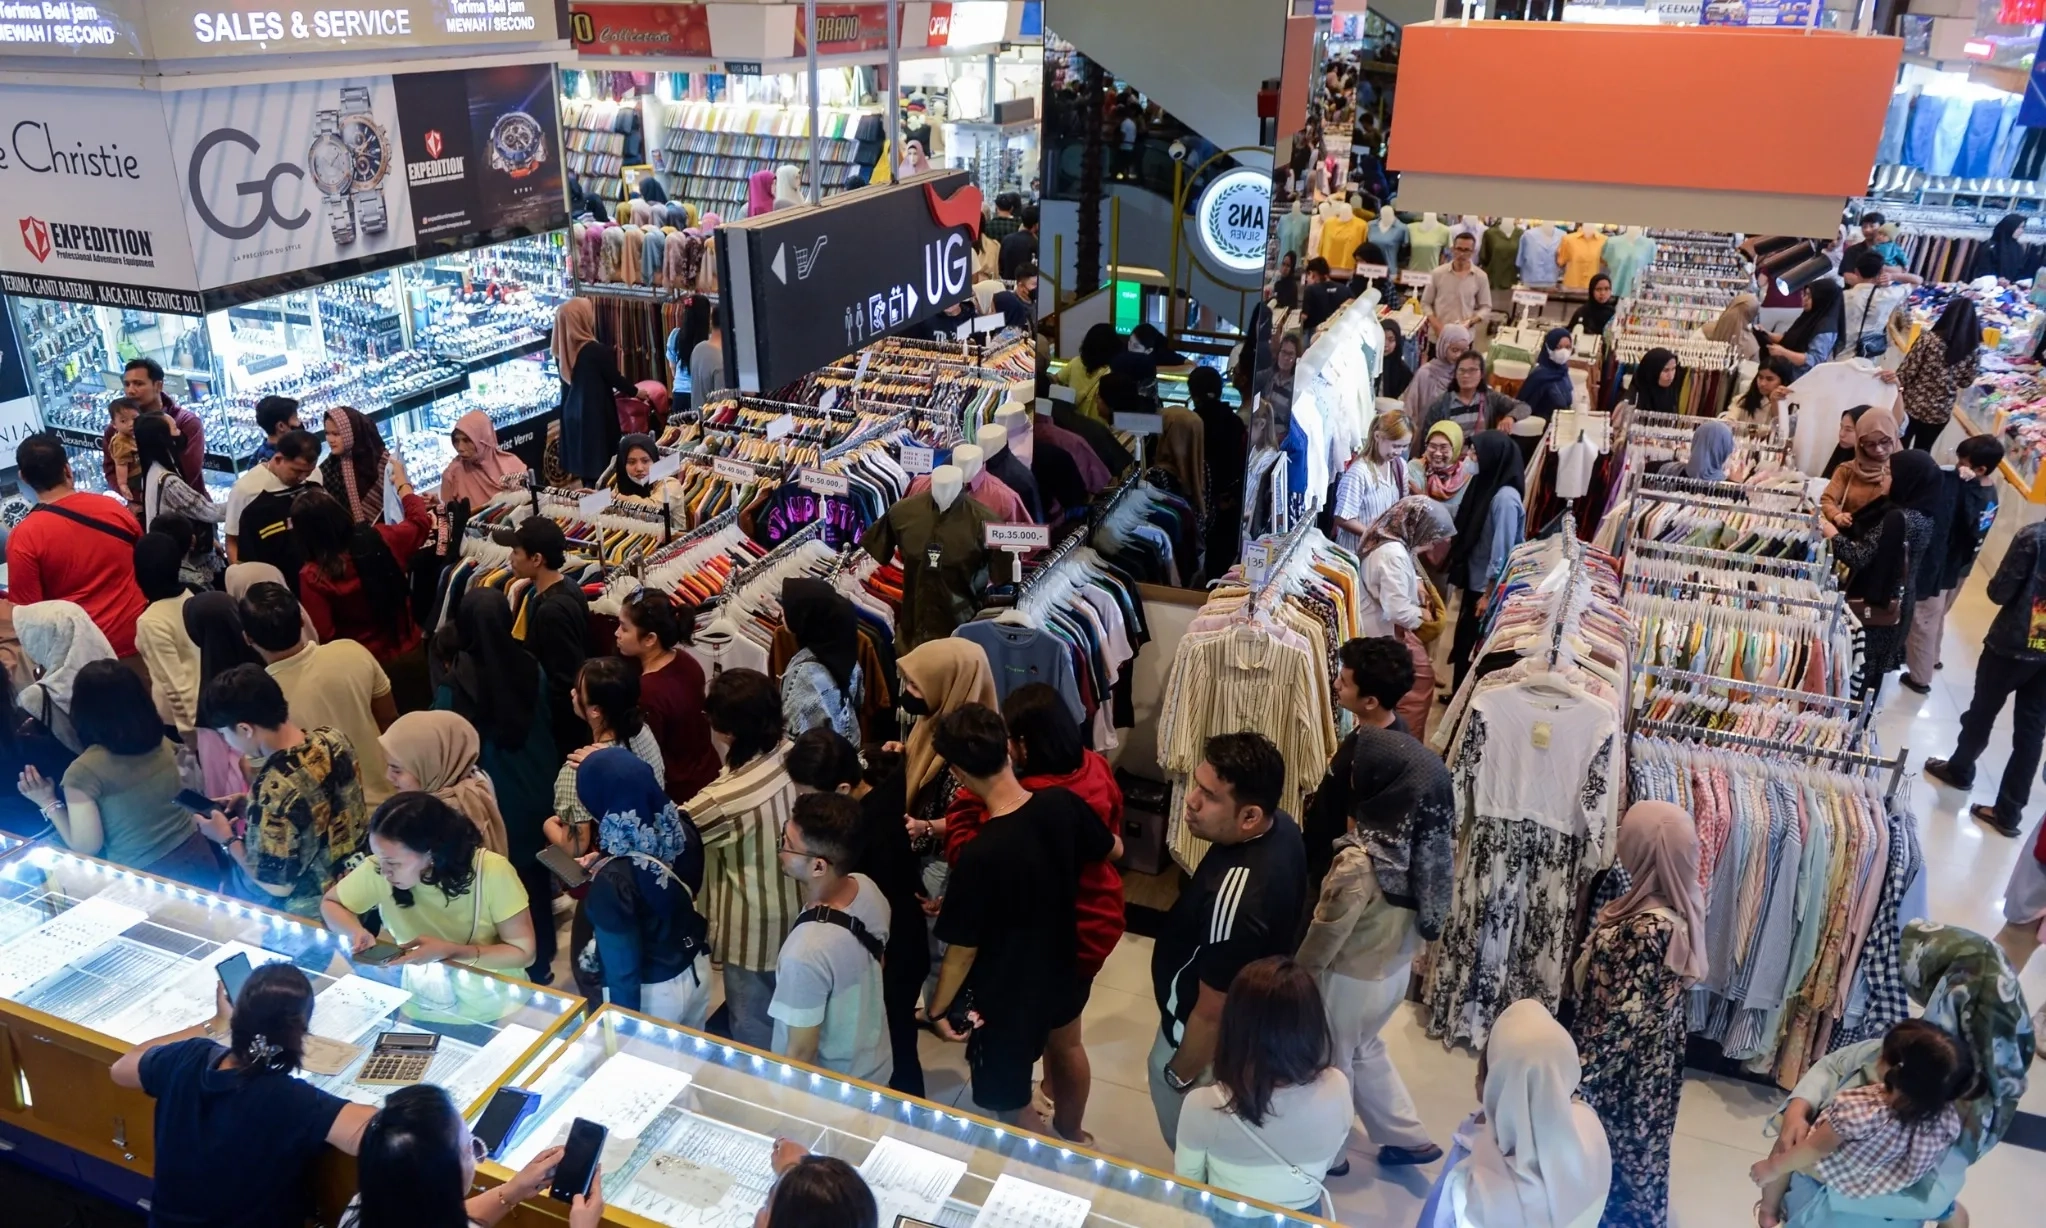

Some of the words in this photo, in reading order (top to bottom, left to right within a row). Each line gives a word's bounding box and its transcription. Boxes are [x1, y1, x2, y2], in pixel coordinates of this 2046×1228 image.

[53, 25, 115, 44] SECOND
[194, 12, 284, 42] SALES
[291, 11, 309, 39] &
[313, 9, 411, 38] SERVICE
[446, 17, 488, 32] MEWAH
[494, 16, 535, 31] SECOND
[816, 15, 858, 42] BRAVO
[12, 120, 140, 179] Christie
[407, 156, 464, 181] EXPEDITION
[50, 222, 153, 257] EXPEDITION
[56, 250, 92, 262] Professional
[93, 254, 122, 265] Adventure
[123, 256, 155, 268] Equipment
[925, 232, 967, 305] UG
[1, 274, 33, 293] TERIMA
[32, 279, 59, 297] GANTI
[59, 281, 94, 300] BATERAI
[147, 291, 183, 311] SERVICE
[56, 430, 95, 448] Alexandre
[991, 530, 1043, 541] Rp.35.000,-
[1247, 557, 1265, 568] 135
